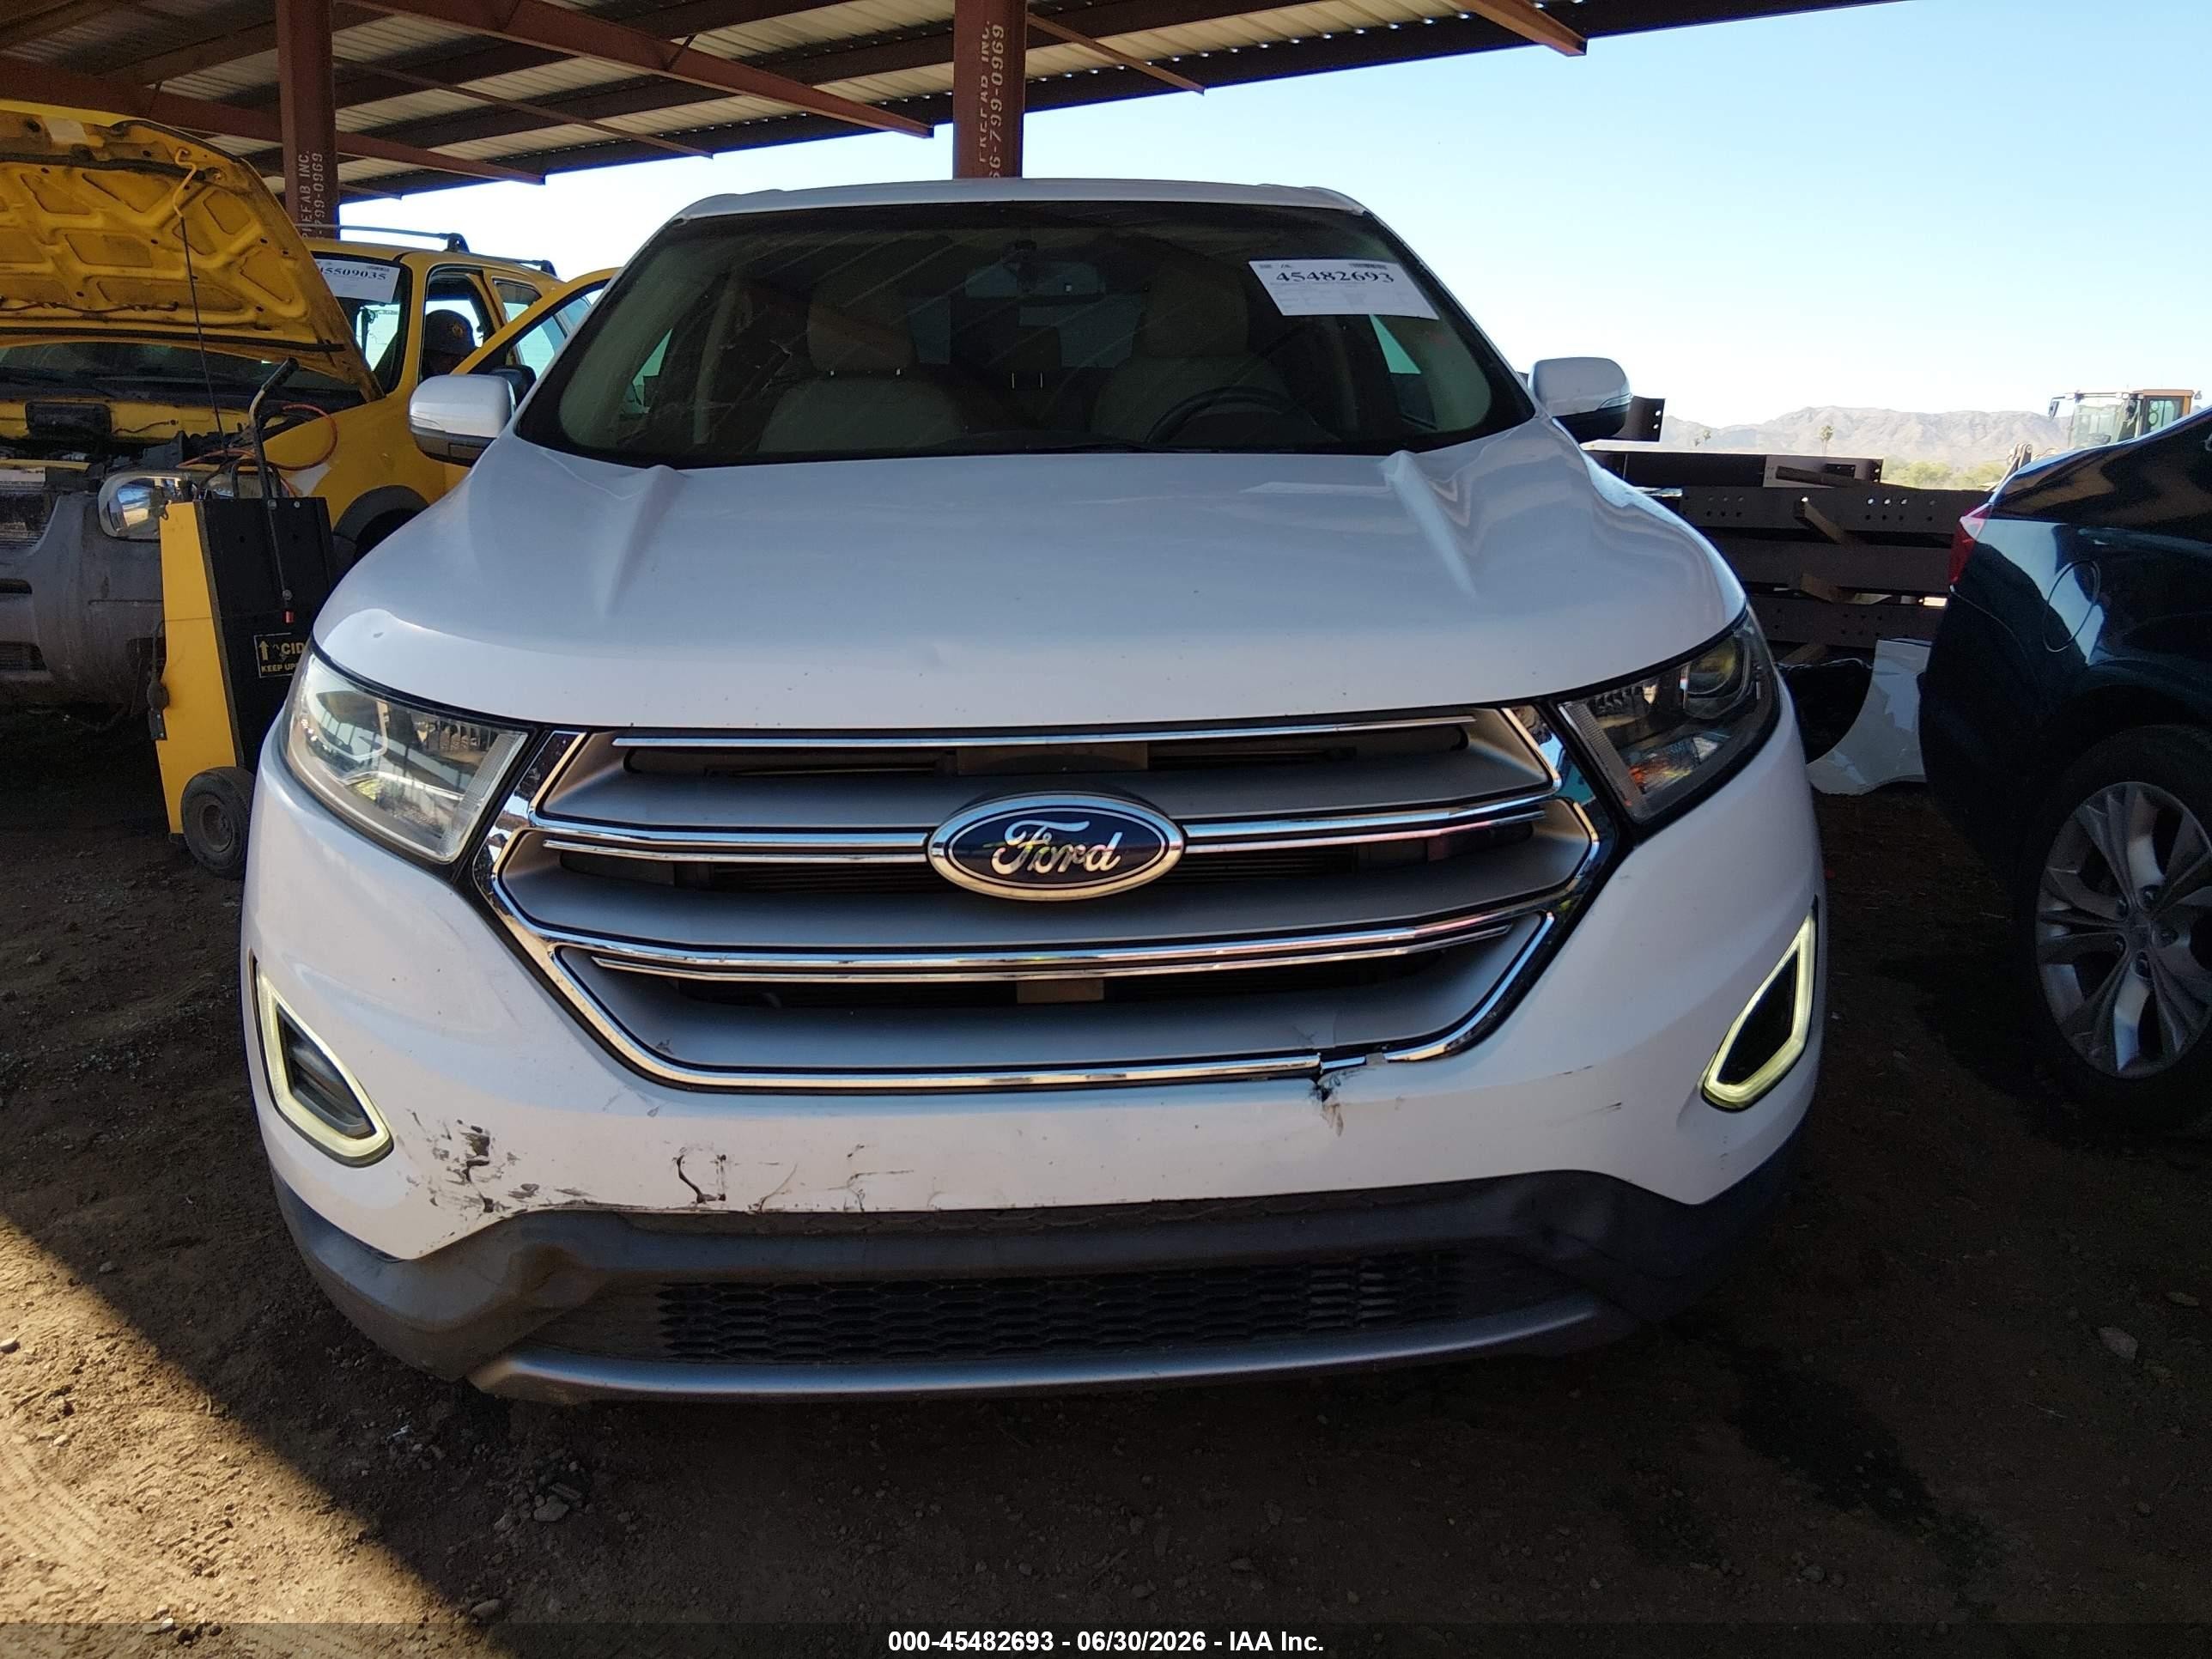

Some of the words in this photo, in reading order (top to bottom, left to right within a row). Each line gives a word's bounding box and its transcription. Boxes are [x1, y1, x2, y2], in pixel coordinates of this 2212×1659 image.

[298, 150, 310, 178] INC.
[312, 153, 325, 239] -799-0969
[1276, 270, 1395, 283] 45482693
[261, 664, 283, 673] KEEP
[992, 819, 1122, 875] Ford
